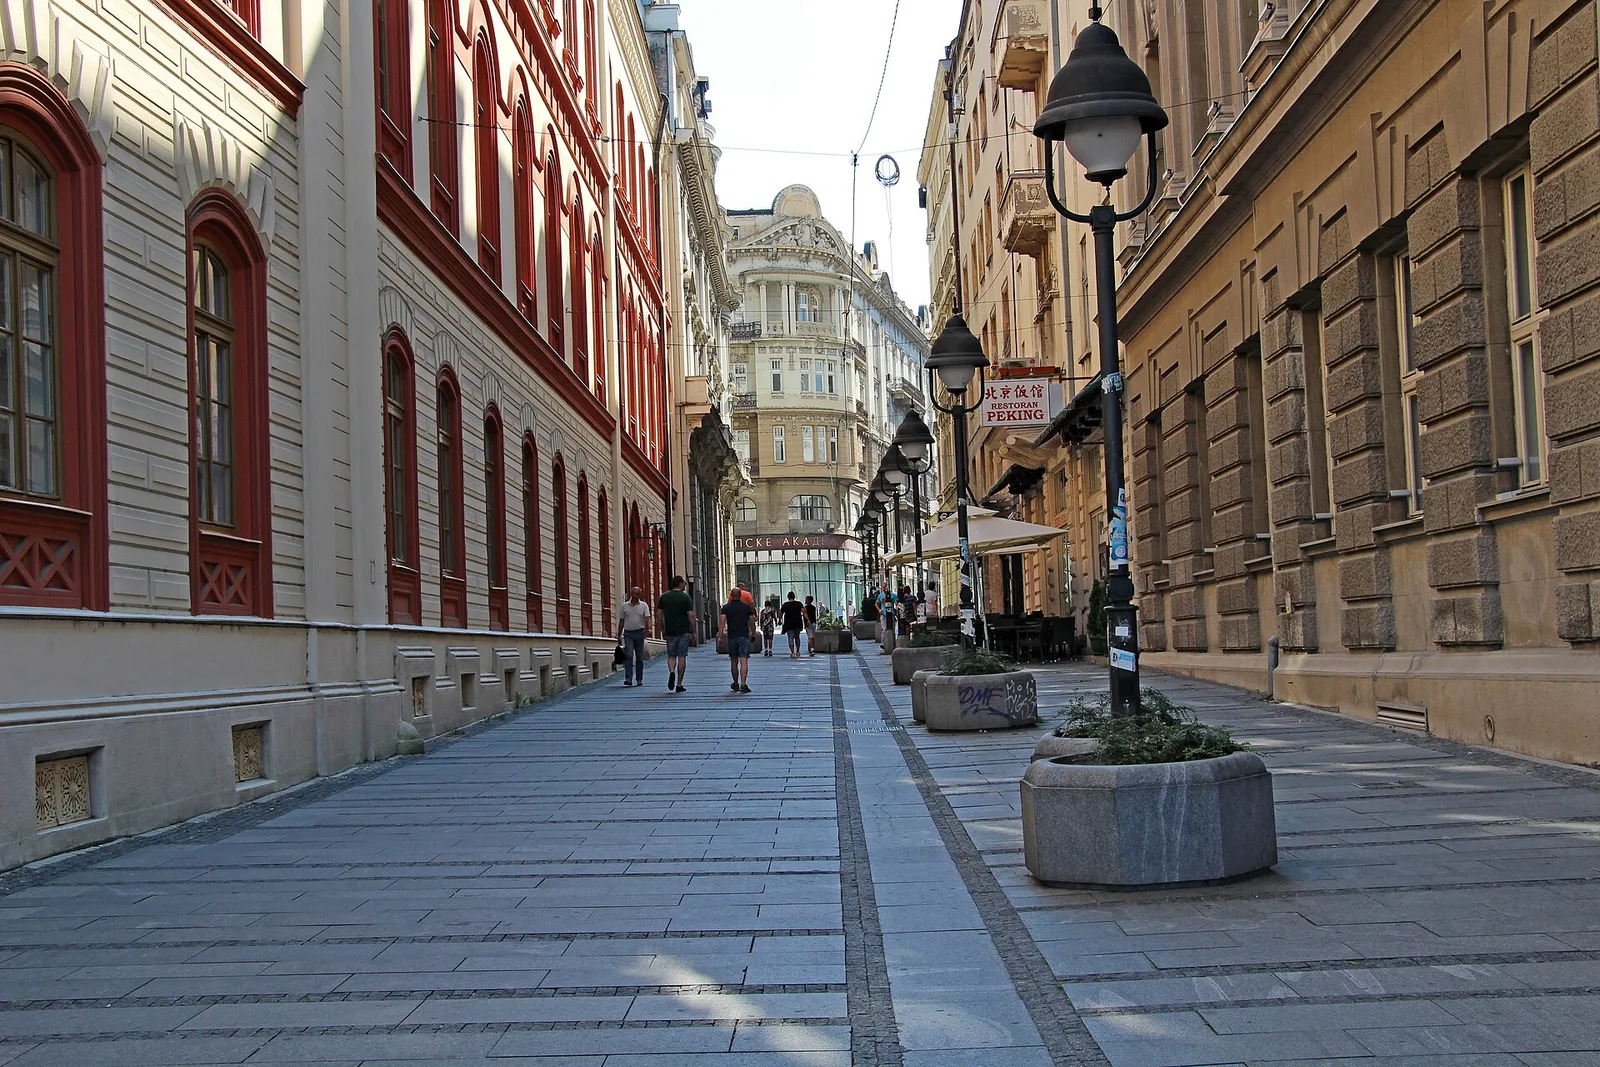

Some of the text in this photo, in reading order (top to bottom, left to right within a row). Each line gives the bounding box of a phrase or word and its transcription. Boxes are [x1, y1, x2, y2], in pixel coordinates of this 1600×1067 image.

[991, 402, 1038, 410] RESTORAN
[987, 410, 1044, 421] PEKING
[782, 536, 836, 547] АКАДЕ
